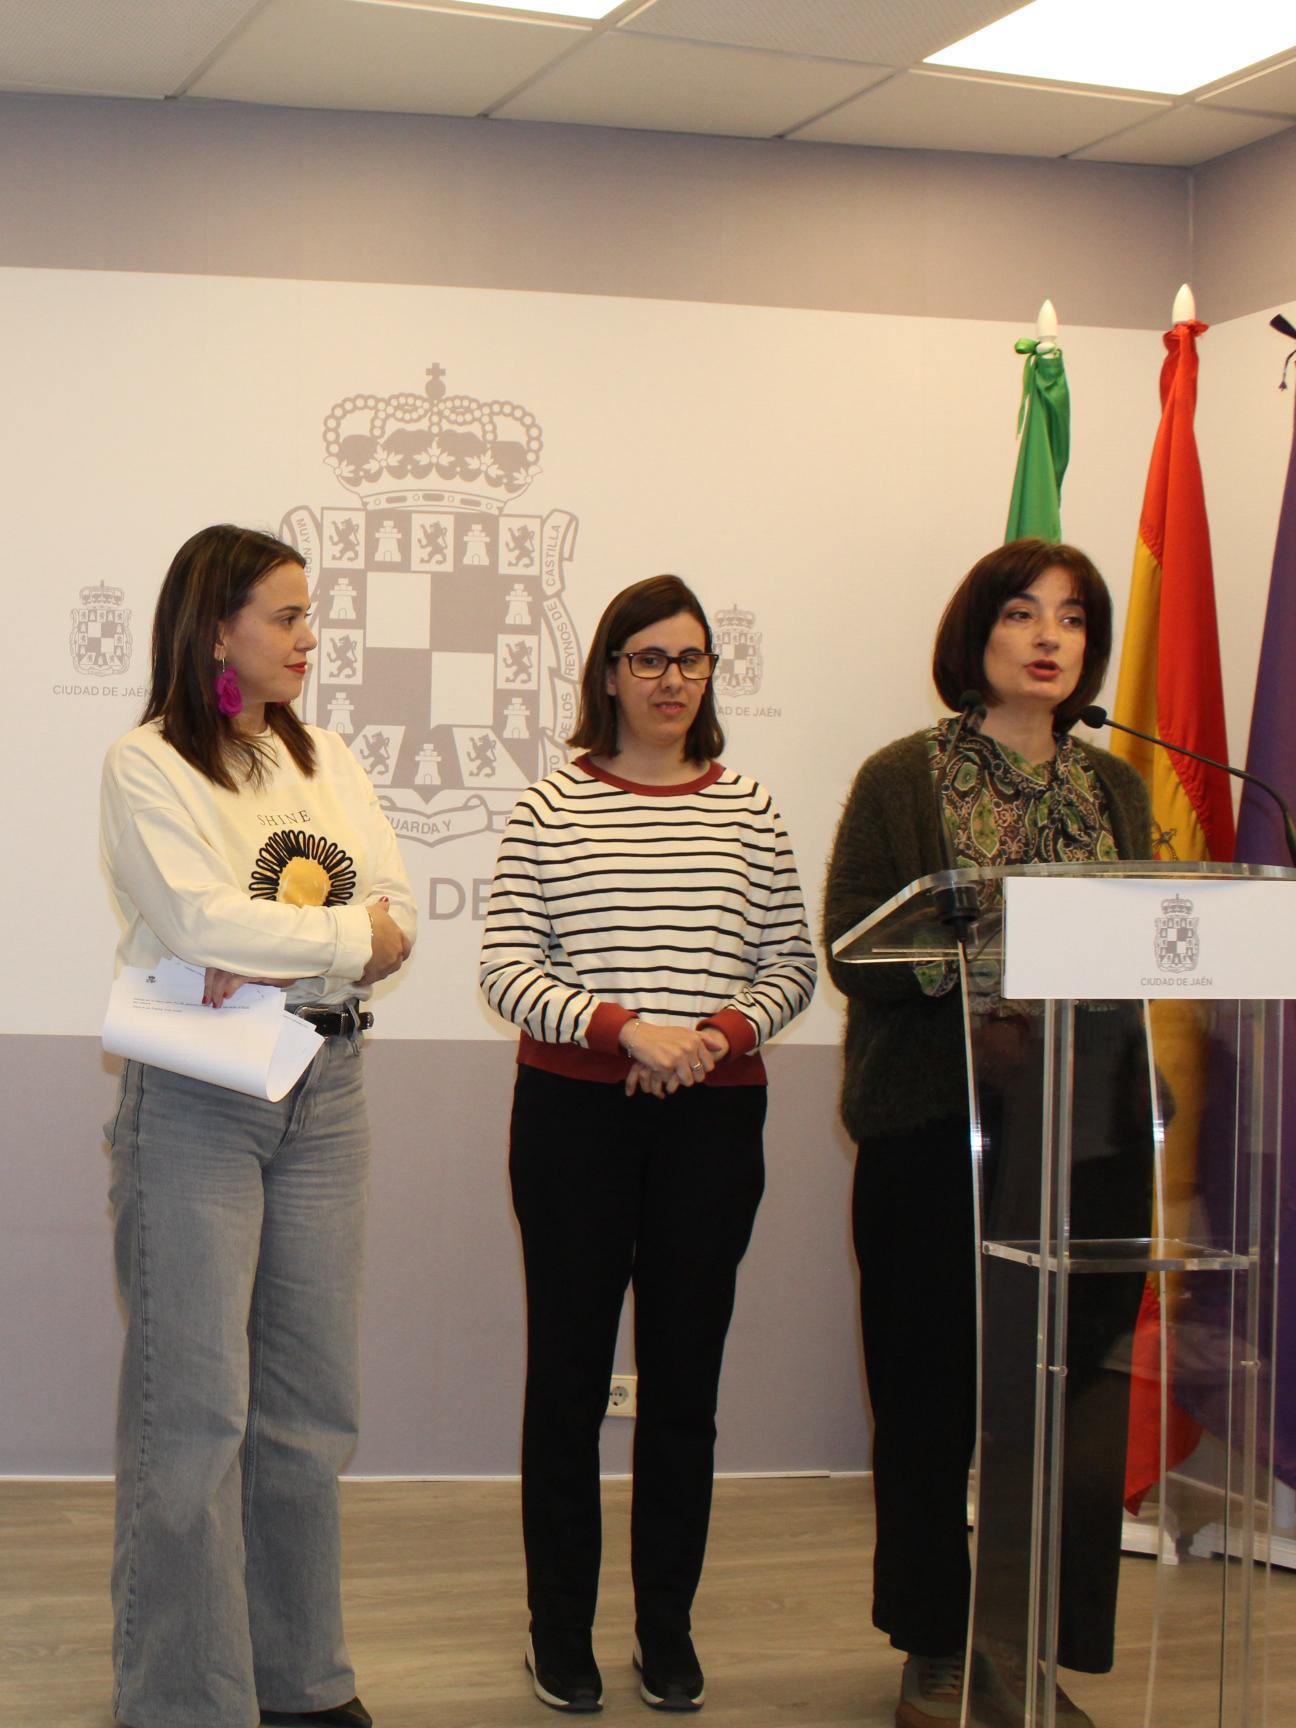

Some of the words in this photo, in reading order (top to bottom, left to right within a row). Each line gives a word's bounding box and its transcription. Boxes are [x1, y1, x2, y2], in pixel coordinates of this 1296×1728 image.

[296, 518, 311, 543] MUY
[303, 547, 313, 578] NOB
[546, 524, 562, 587] CASTILLA
[547, 601, 562, 619] DE
[557, 622, 575, 677] REYNOS
[52, 684, 99, 696] CIUDAD
[102, 686, 118, 697] DE
[121, 685, 152, 697] JAÉN
[561, 691, 572, 719] LOS
[735, 706, 750, 716] DE
[753, 705, 782, 717] JAÉN
[559, 724, 570, 740] DE
[256, 809, 311, 827] SHINE
[385, 815, 440, 835] UARDA
[442, 818, 452, 832] Y
[1140, 977, 1174, 986] CIUDAD
[1176, 977, 1188, 986] DE
[1190, 975, 1213, 986] JAÉN
